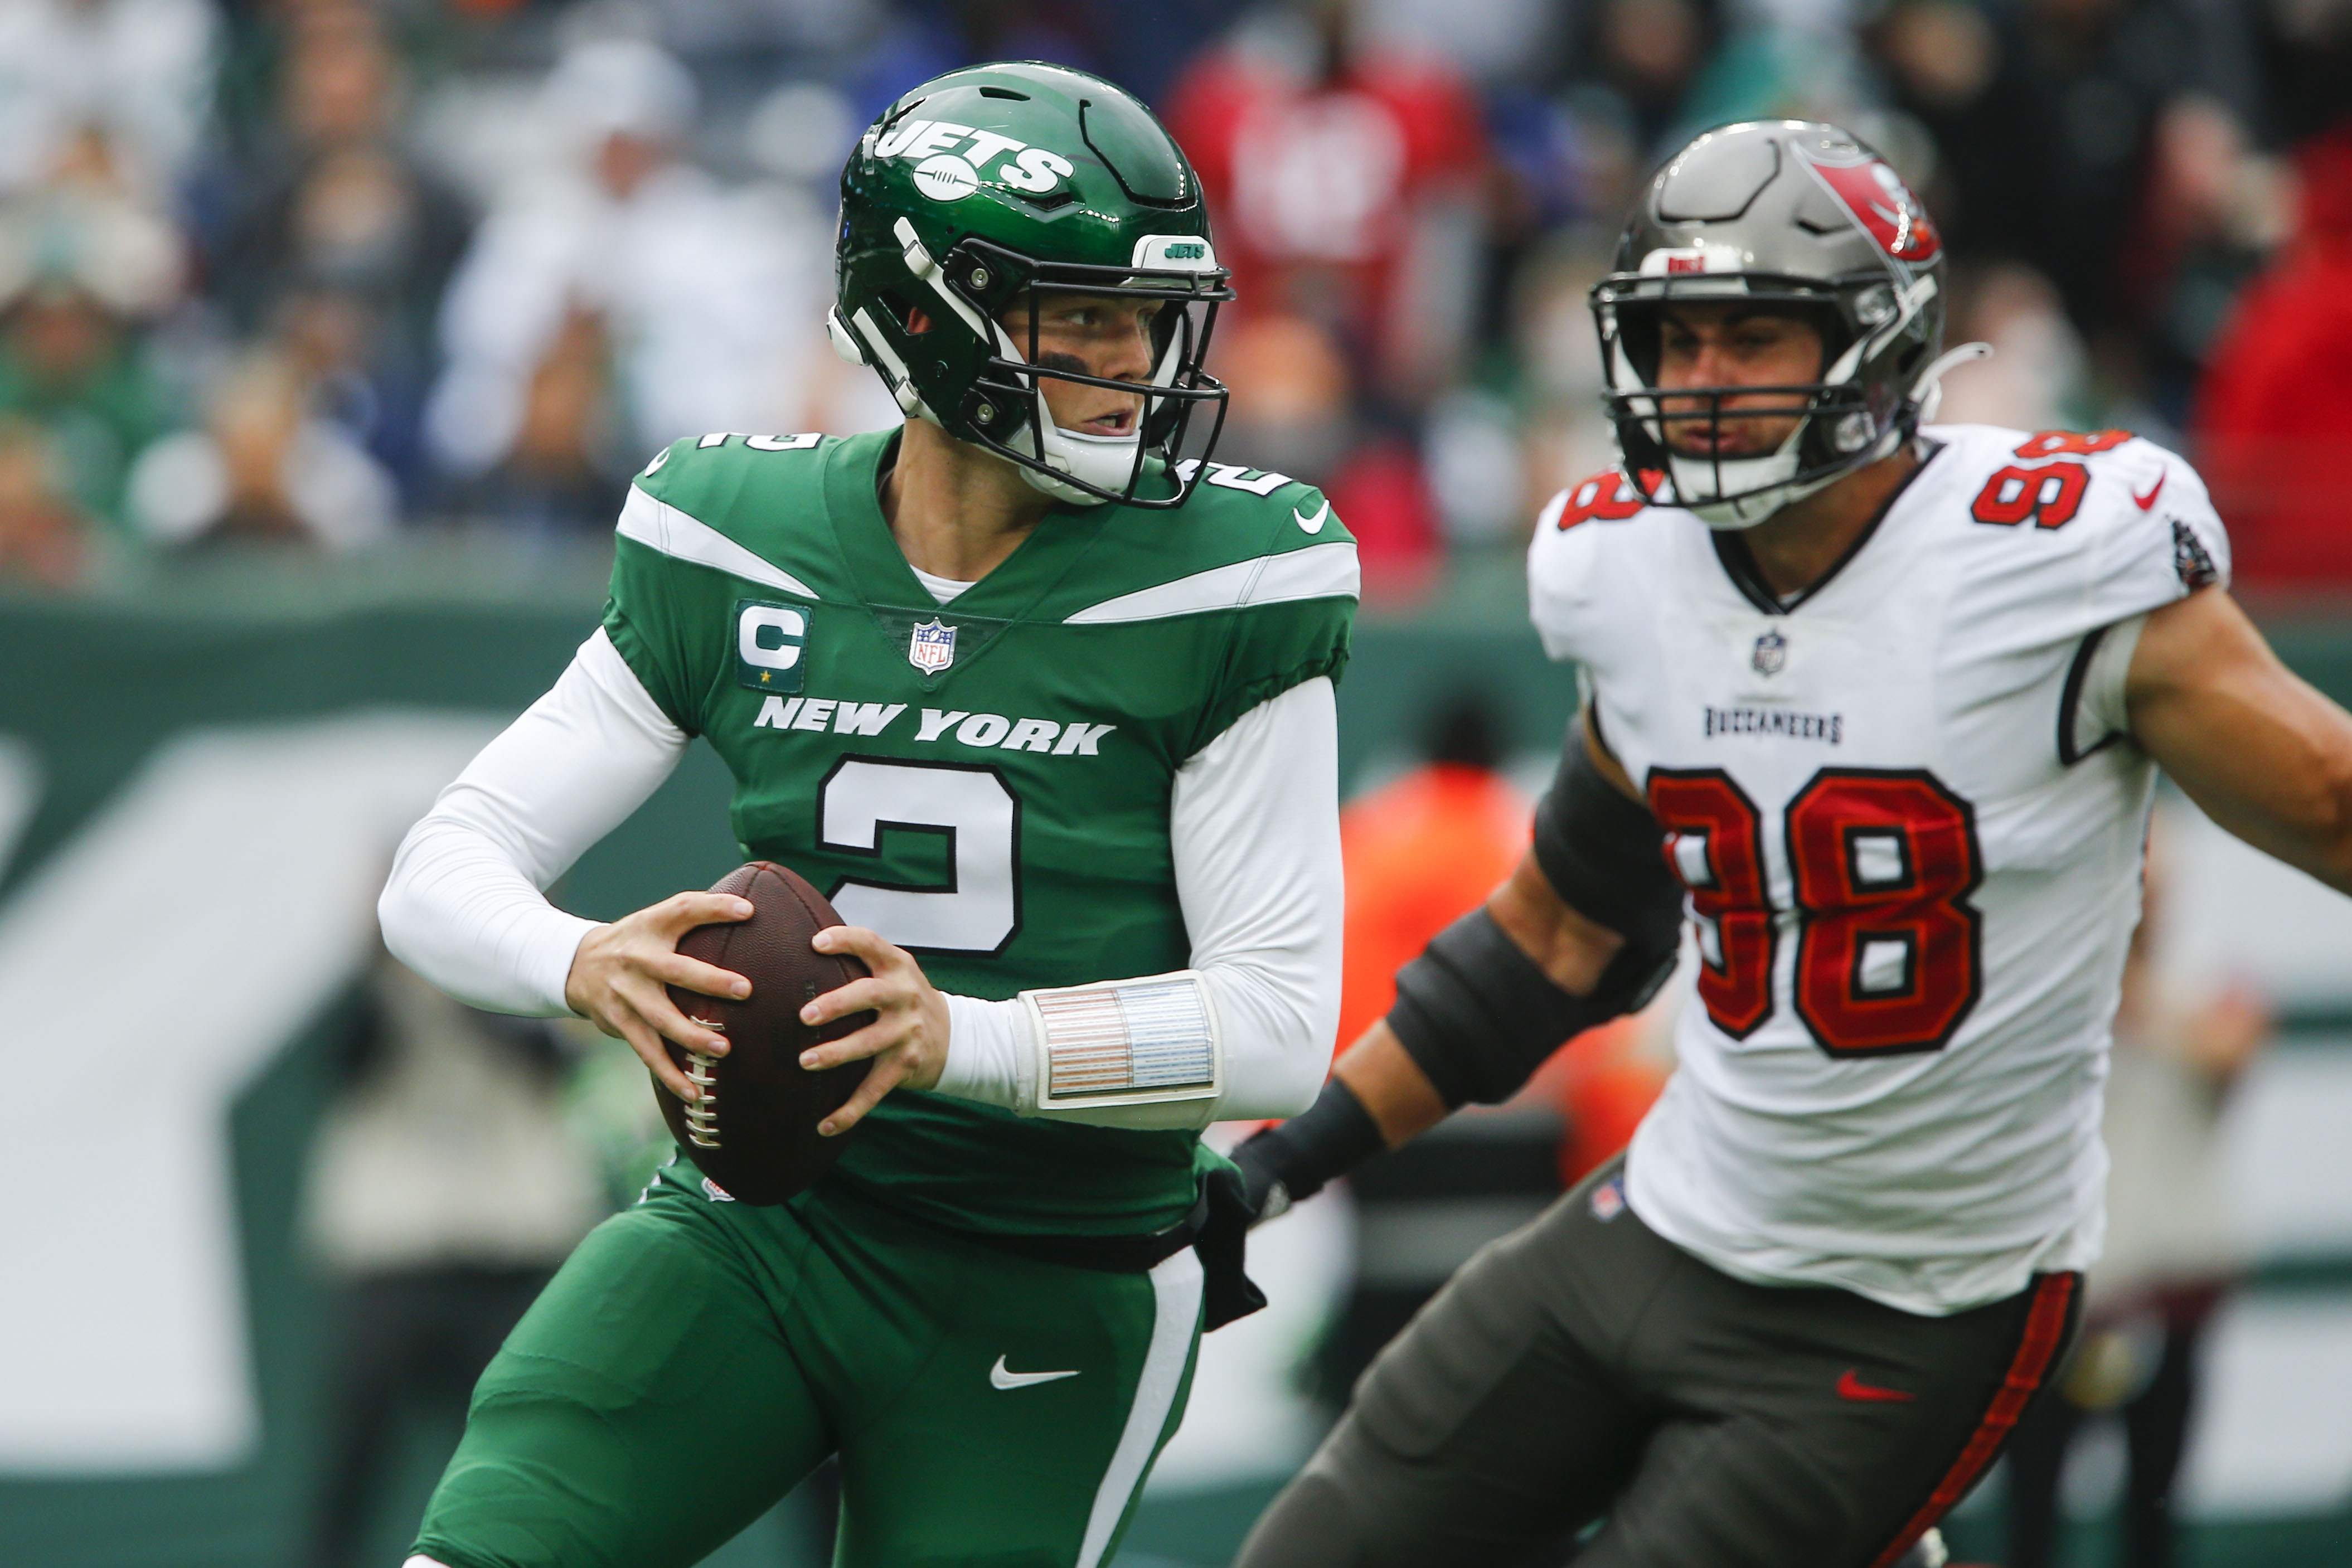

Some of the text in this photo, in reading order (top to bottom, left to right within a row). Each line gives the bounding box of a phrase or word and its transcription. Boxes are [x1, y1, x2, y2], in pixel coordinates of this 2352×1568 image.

[874, 120, 1074, 193] JETS
[1165, 243, 1205, 259] JETS
[739, 605, 804, 670] C
[917, 644, 947, 663] NFL
[754, 696, 1117, 756] NEW YORK
[1705, 707, 1842, 745] BUCCANEERS
[816, 752, 1021, 959] 2
[1646, 766, 1985, 1059] 98
